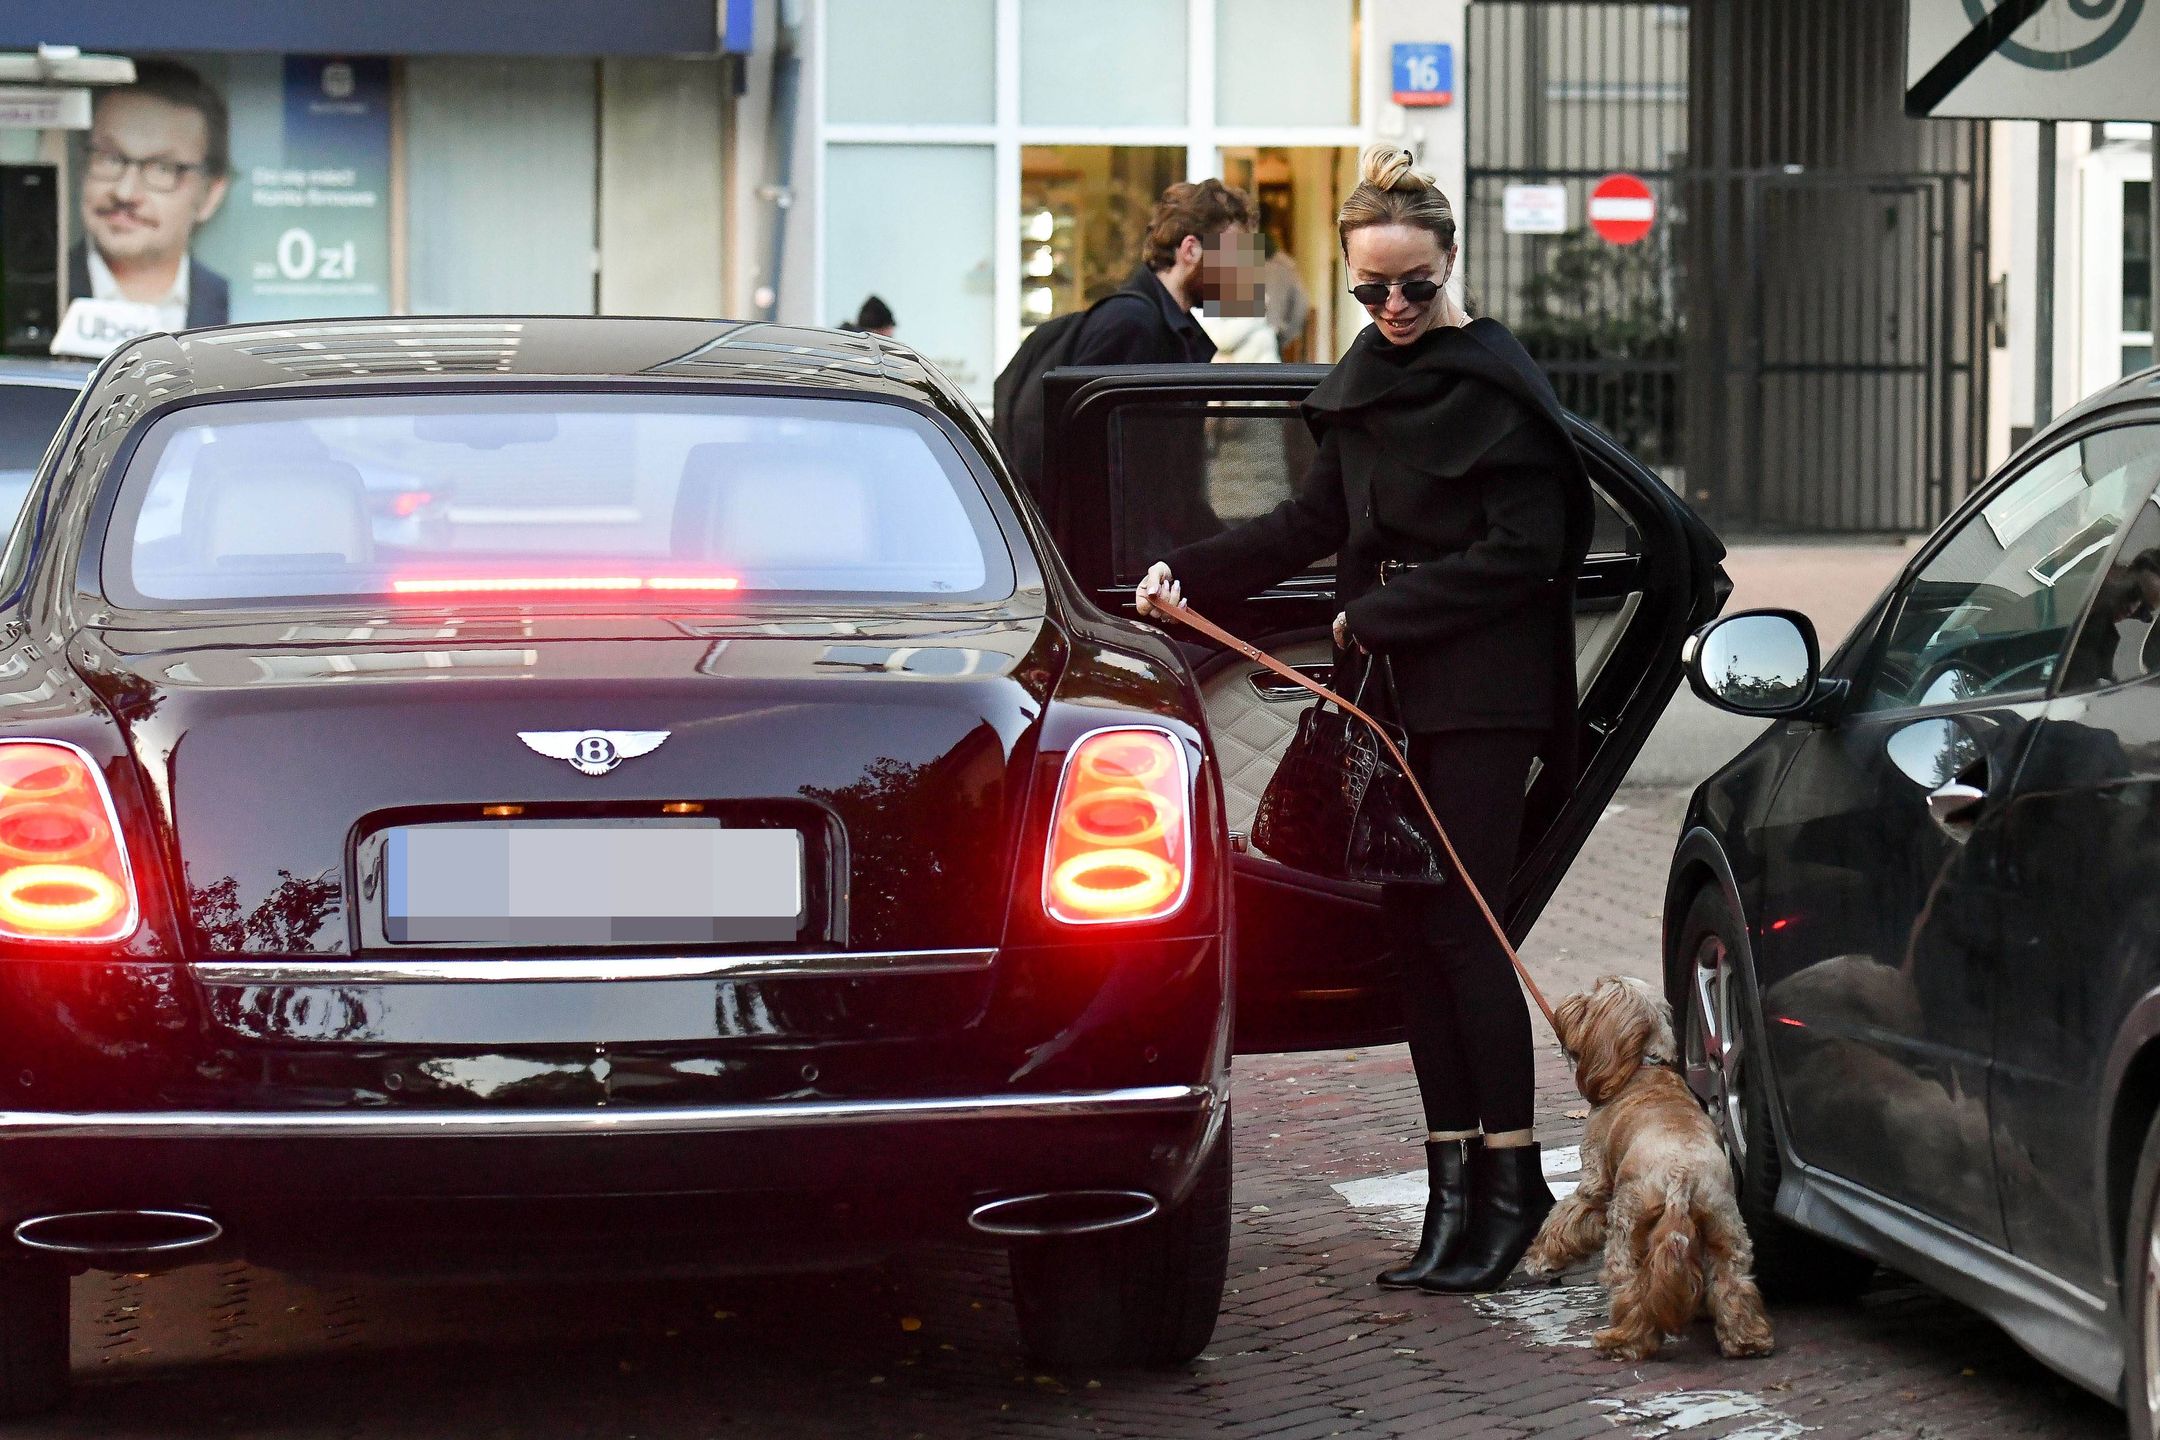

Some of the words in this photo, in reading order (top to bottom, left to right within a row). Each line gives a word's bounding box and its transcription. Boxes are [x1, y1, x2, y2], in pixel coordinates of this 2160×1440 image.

[1406, 55, 1439, 91] 16
[277, 227, 316, 280] 0
[582, 737, 609, 763] B
